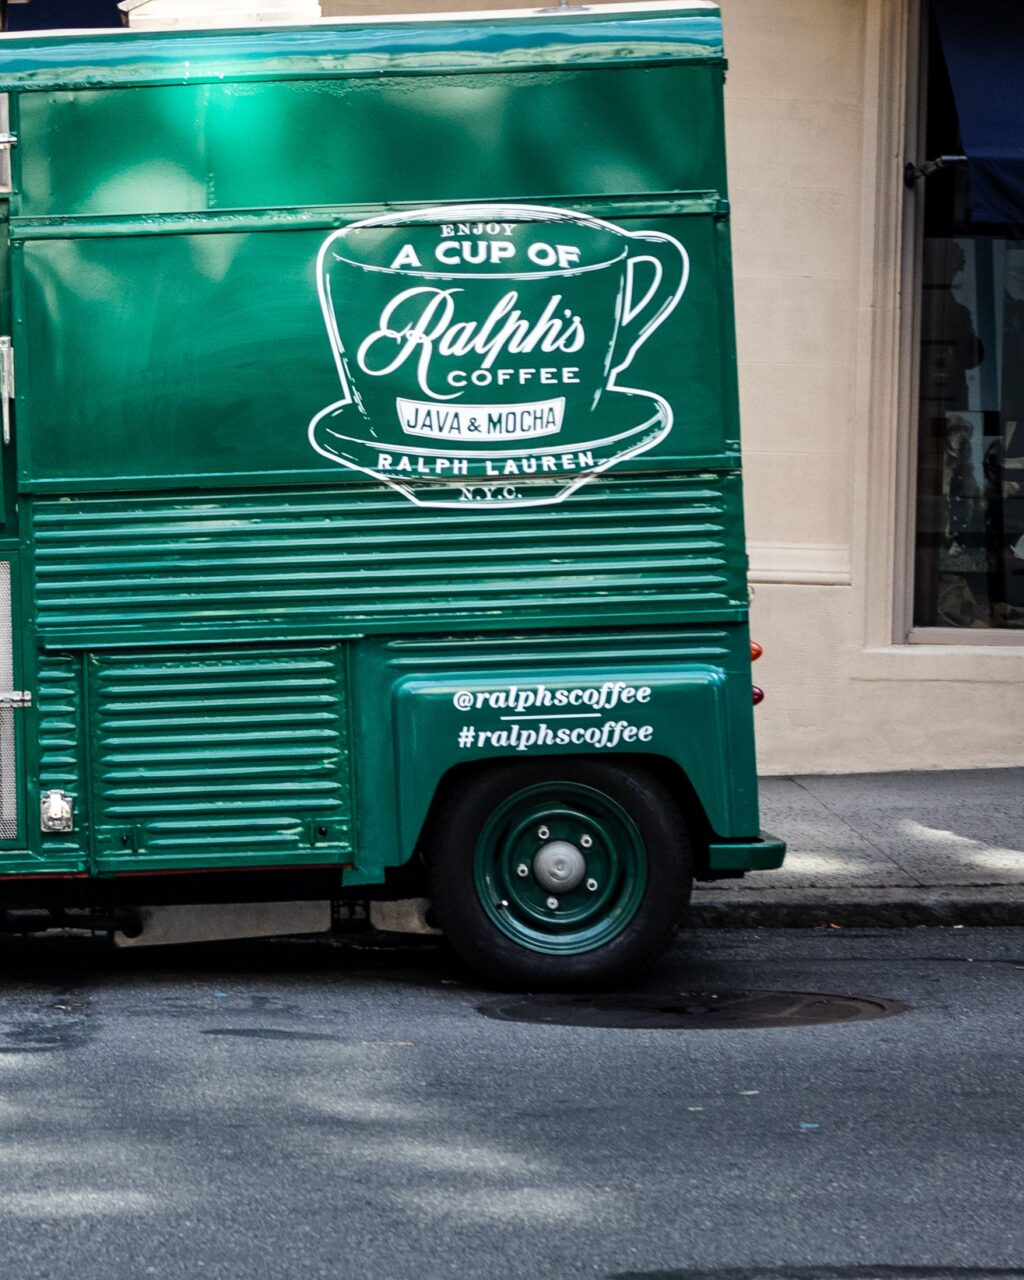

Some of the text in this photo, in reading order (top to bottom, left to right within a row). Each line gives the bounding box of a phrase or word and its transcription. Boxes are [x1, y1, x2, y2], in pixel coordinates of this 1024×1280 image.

[440, 222, 518, 237] ENJOY
[390, 240, 582, 269] A CUP OF
[357, 286, 585, 400] Ralph's
[446, 368, 580, 387] COFFEE
[406, 407, 557, 434] JAVA & MOCHA
[378, 451, 594, 476] RALPH LAUREN
[458, 486, 523, 501] N.Y.C.
[453, 681, 652, 712] @ralphscoffee
[458, 720, 653, 751] #ralphscoffee
